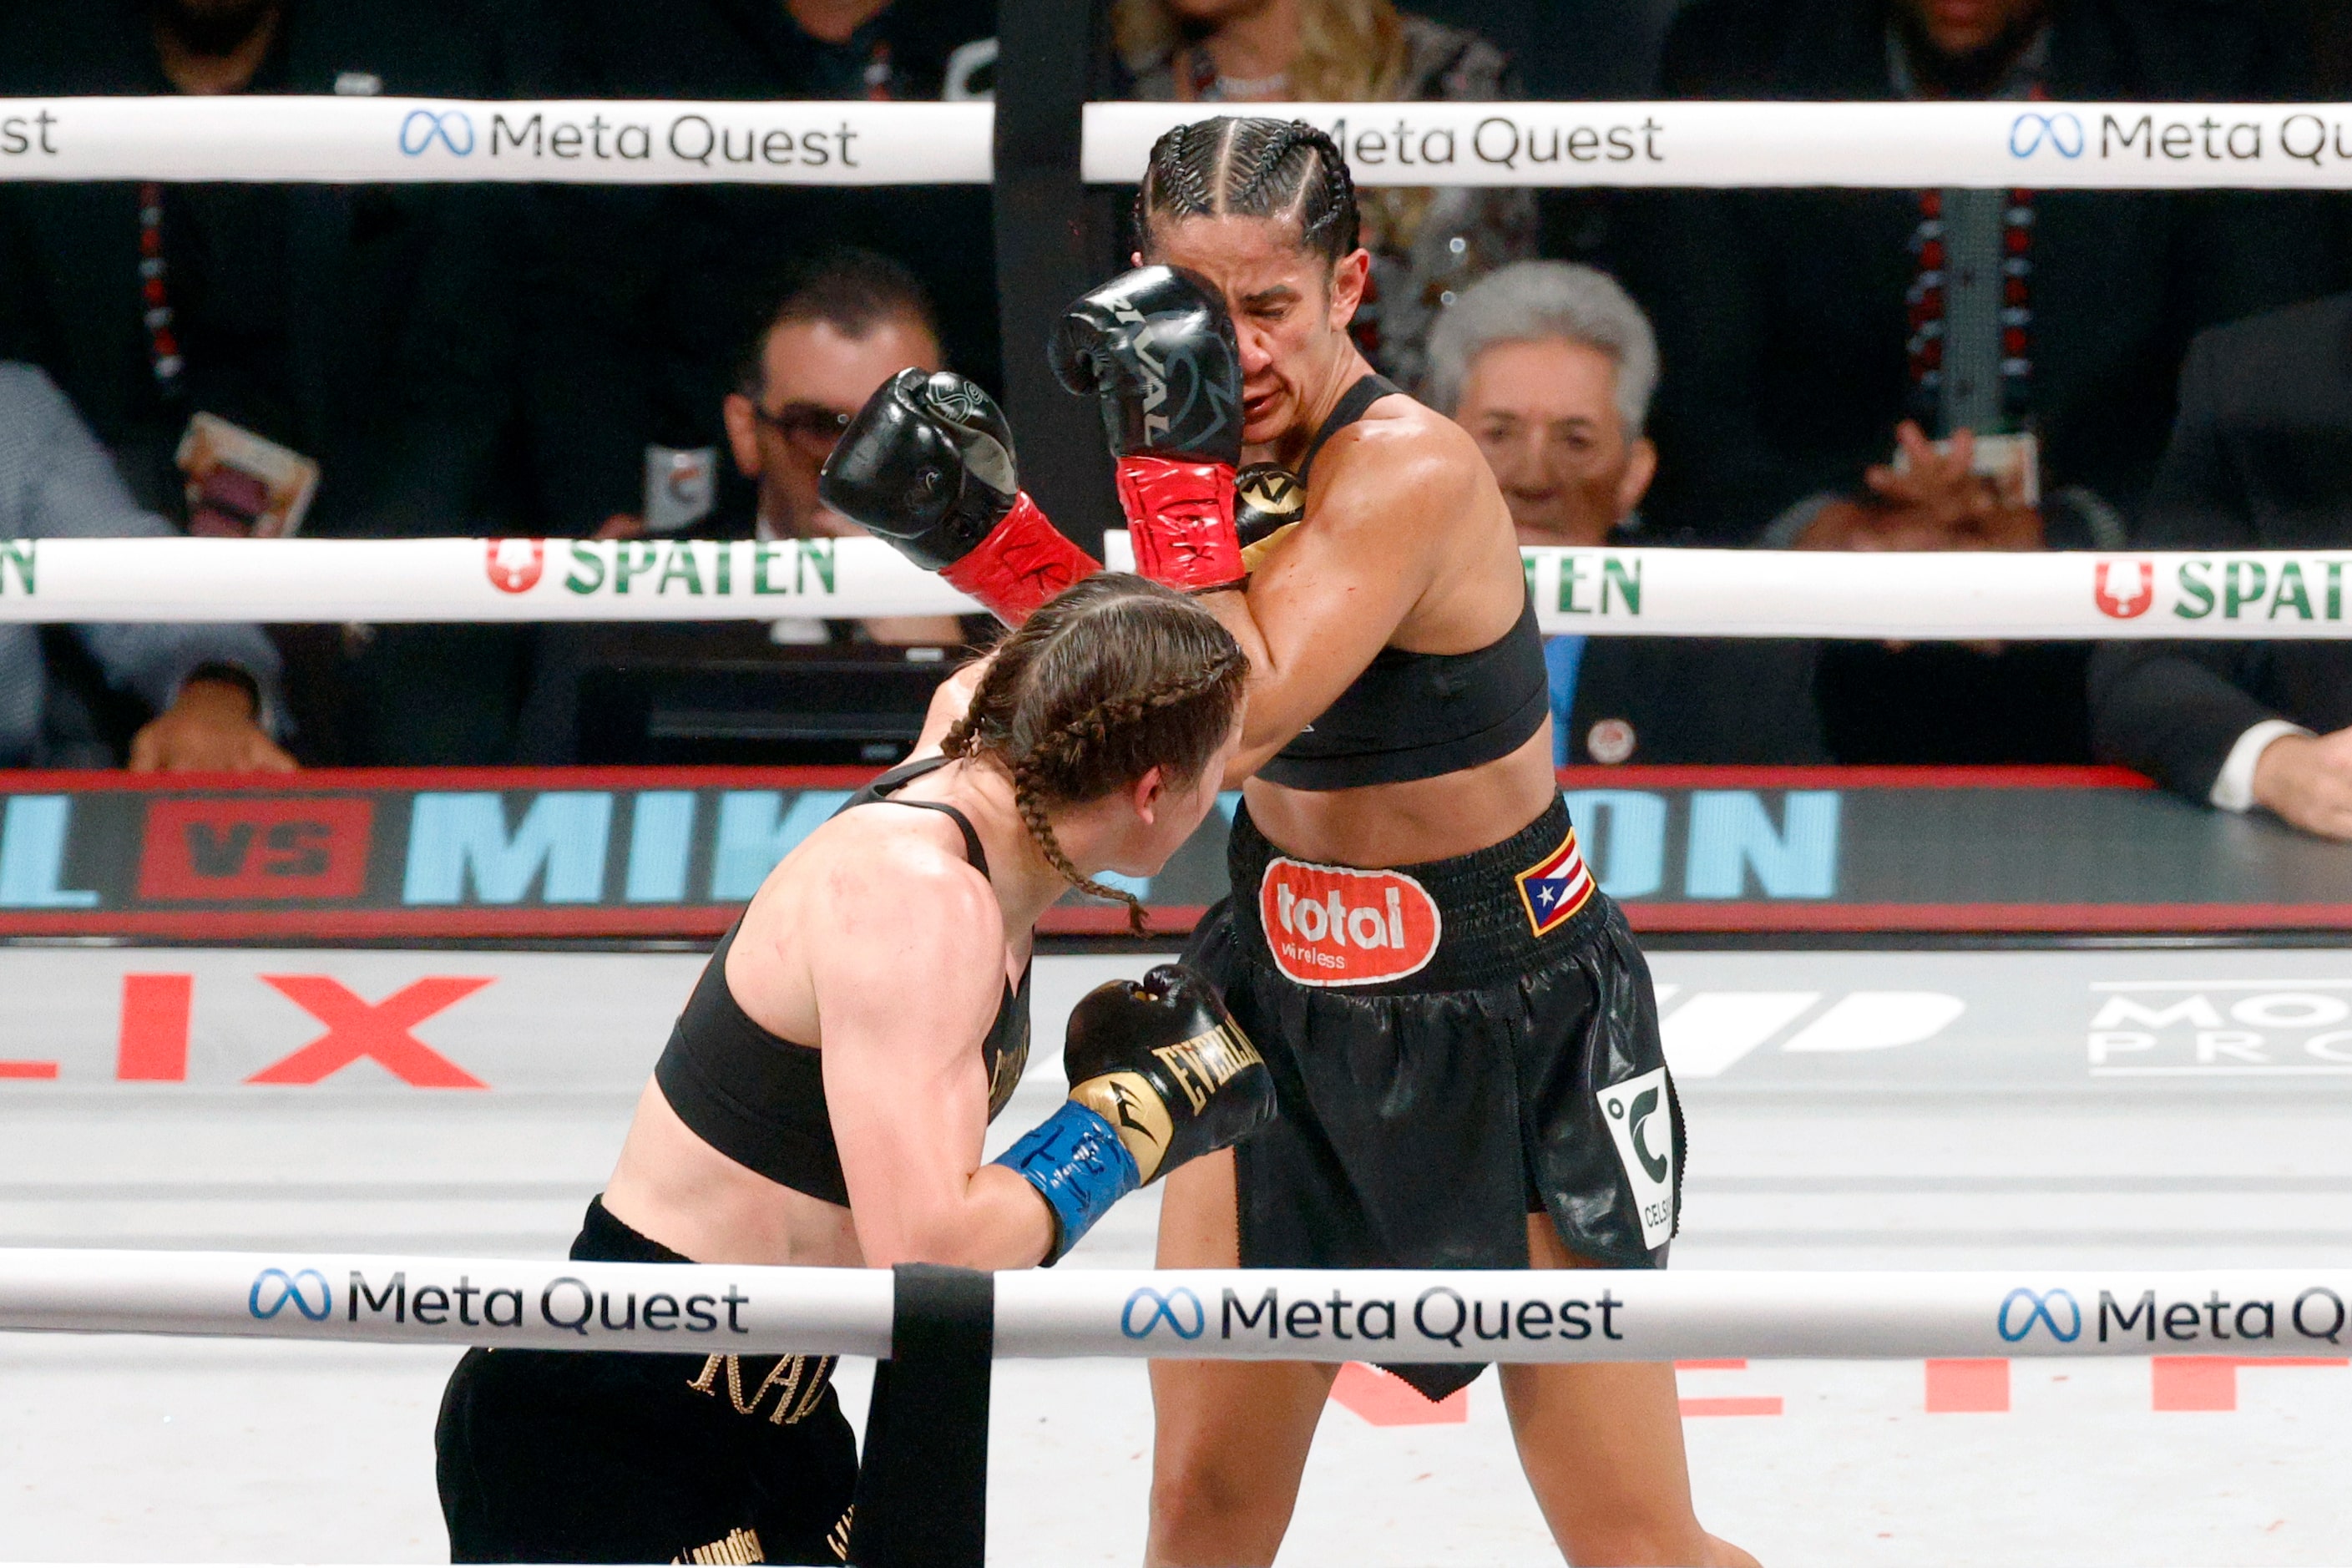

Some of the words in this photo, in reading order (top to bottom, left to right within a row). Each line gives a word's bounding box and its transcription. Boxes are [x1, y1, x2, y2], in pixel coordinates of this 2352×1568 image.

[489, 113, 650, 160] Meta
[668, 114, 859, 167] Quest
[1472, 116, 1664, 170] Quest
[2101, 114, 2261, 159] Meta
[564, 539, 837, 595] SPATEN
[182, 821, 331, 878] VS
[1277, 883, 1405, 950] total
[1281, 942, 1346, 970] wireless
[347, 1269, 524, 1328] Meta
[540, 1277, 750, 1335] Quest
[1220, 1287, 1396, 1339] Meta
[1413, 1286, 1624, 1348] Quest
[2097, 1289, 2274, 1342] Meta
[2291, 1286, 2352, 1344] Q
